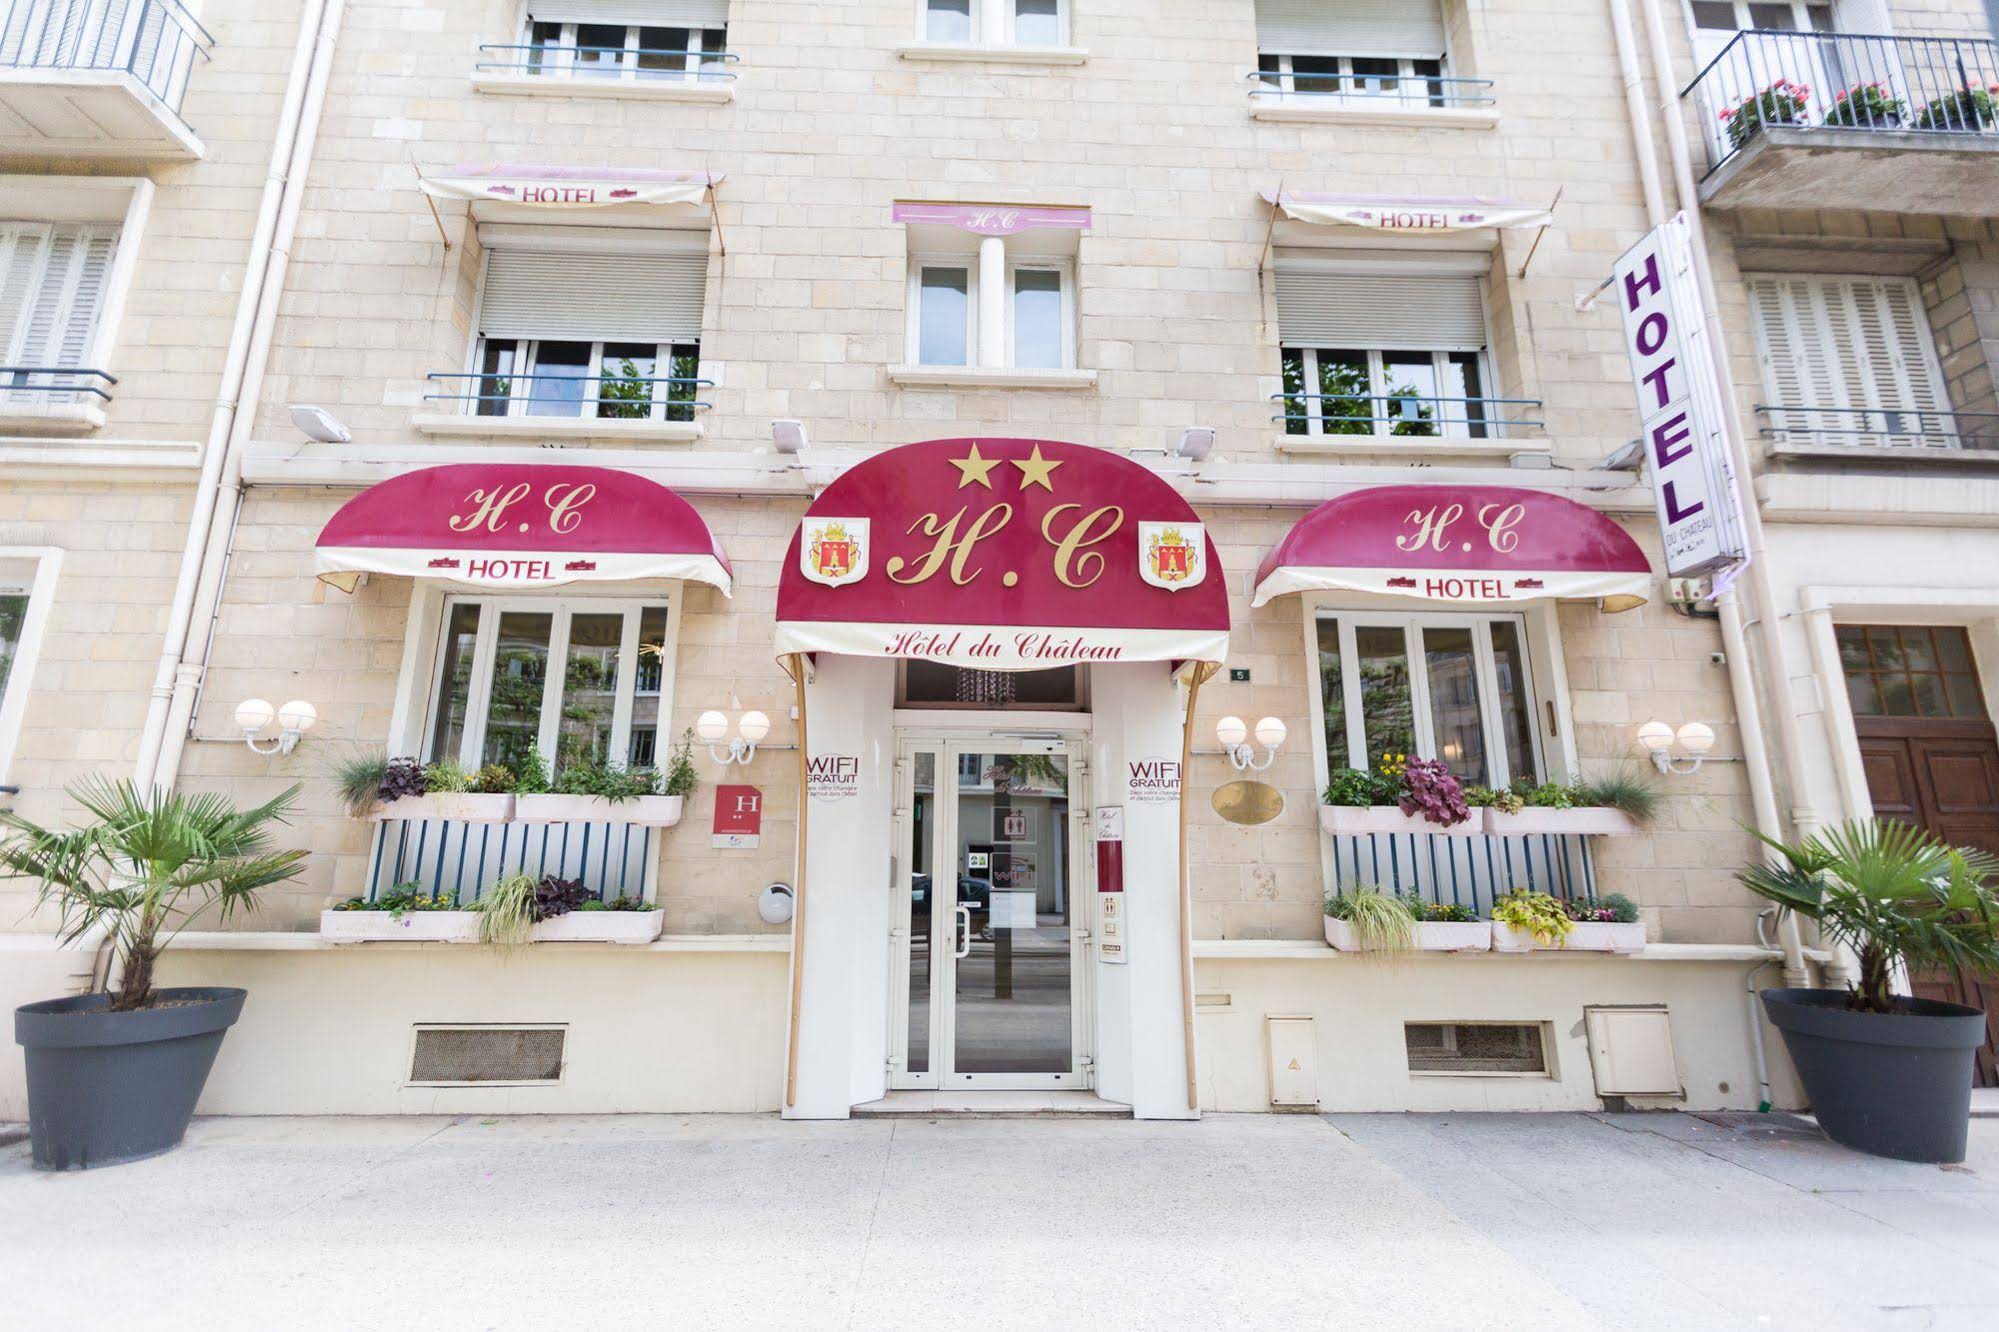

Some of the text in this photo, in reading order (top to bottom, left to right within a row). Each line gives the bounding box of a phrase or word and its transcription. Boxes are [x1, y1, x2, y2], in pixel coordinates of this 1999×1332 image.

[1624, 252, 1704, 526] HOTEL
[468, 559, 556, 580] HOTEL
[1426, 578, 1511, 599] HOTEL
[885, 631, 1122, 659] Hôtel du Château
[1237, 671, 1244, 680] 5
[807, 757, 858, 774] WIFI
[1129, 761, 1181, 779] WIFI
[1129, 778, 1182, 788] GRATUIT
[736, 795, 760, 812] H
